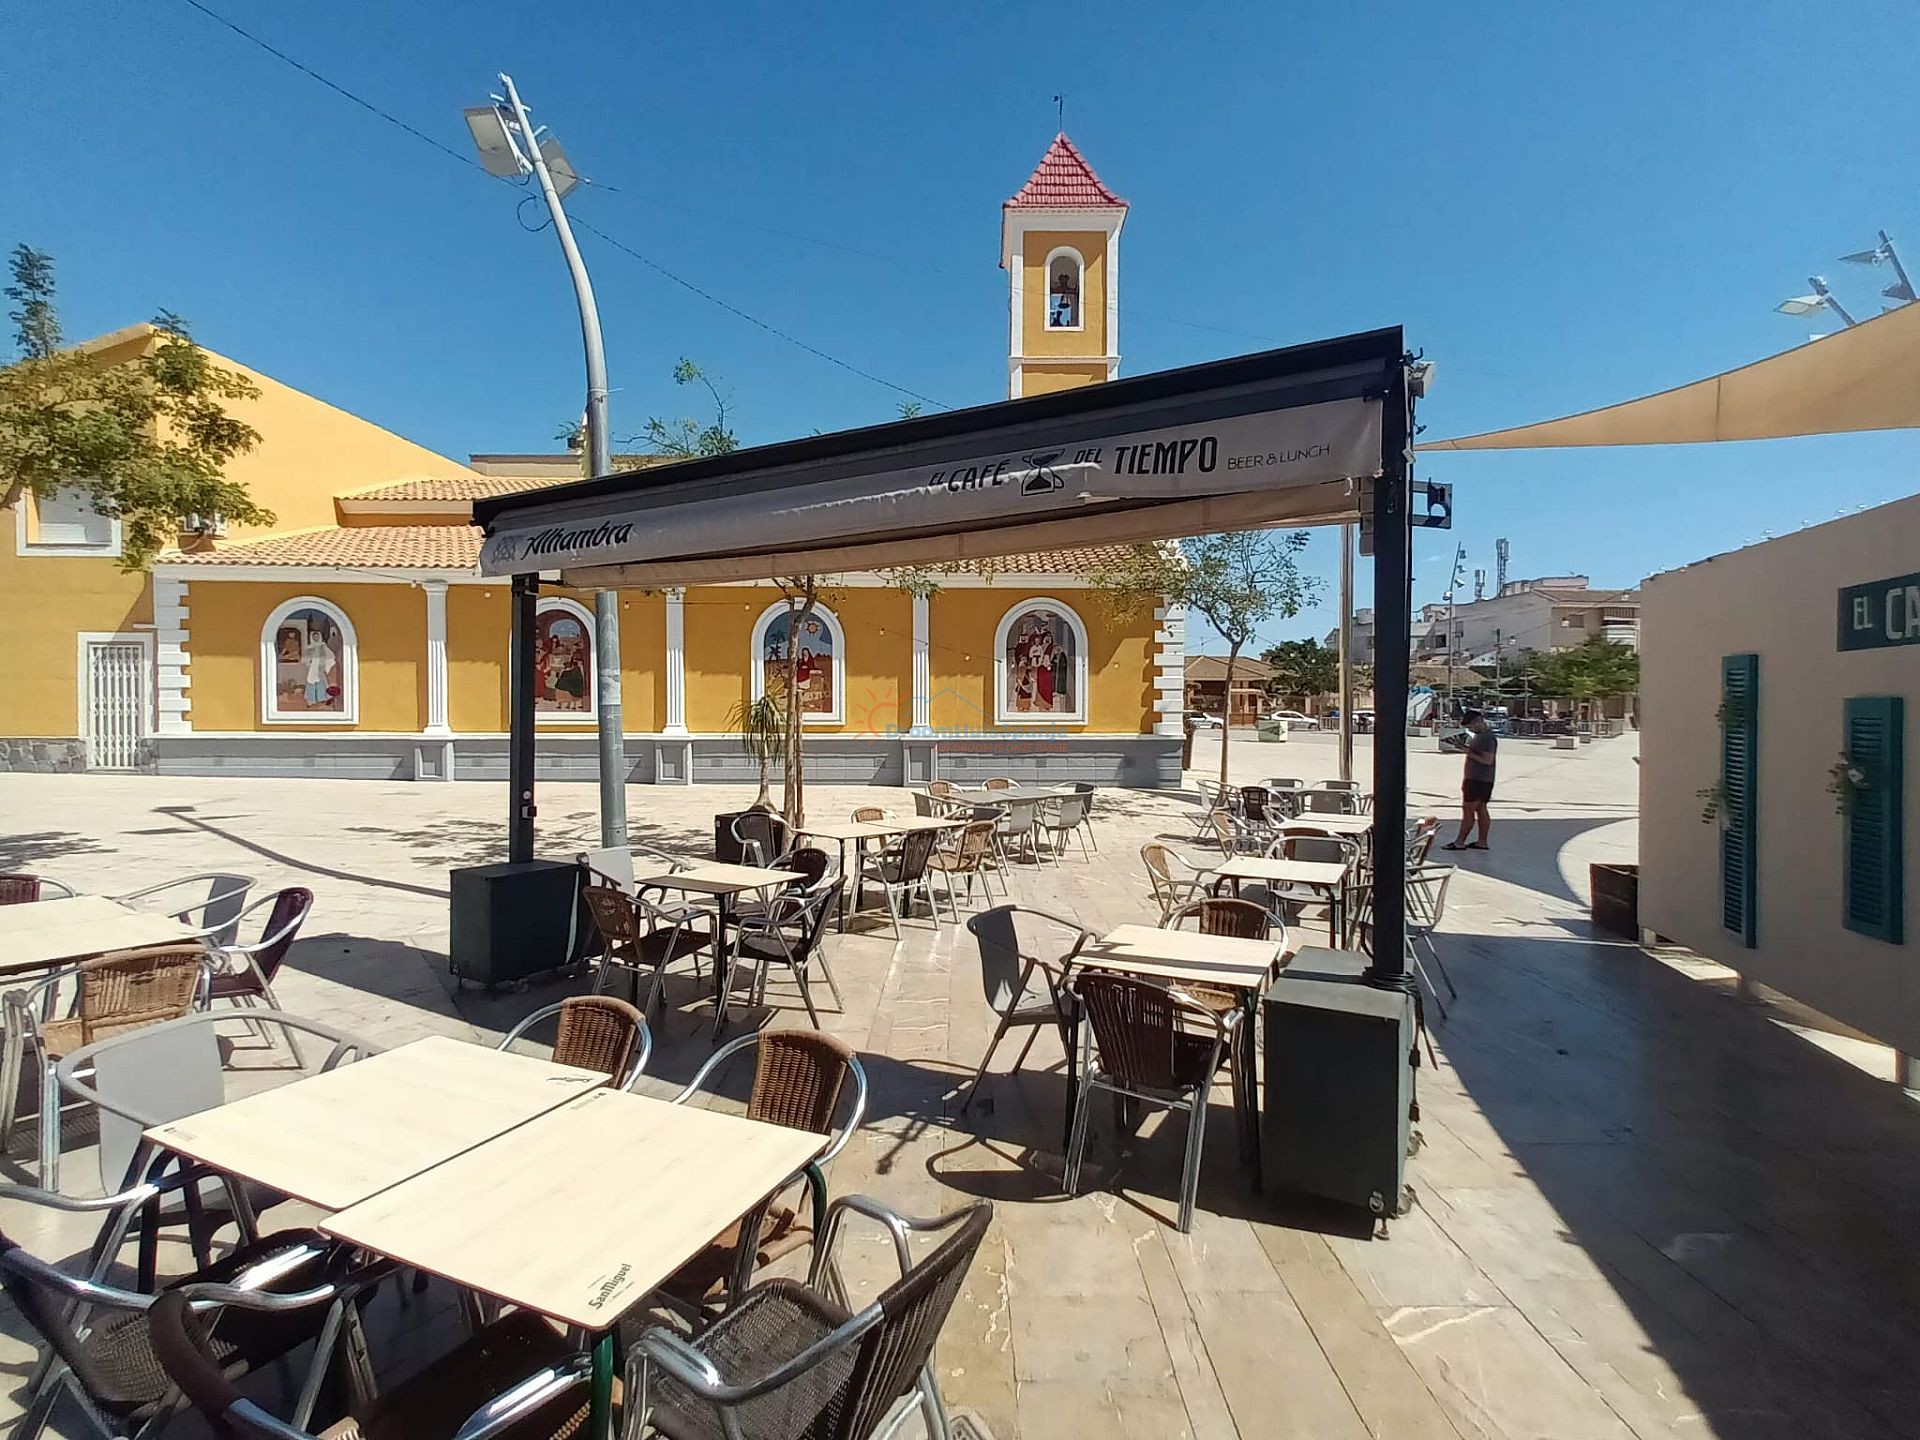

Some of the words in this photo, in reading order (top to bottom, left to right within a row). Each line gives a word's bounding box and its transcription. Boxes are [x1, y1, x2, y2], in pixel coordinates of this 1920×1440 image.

[1074, 448, 1102, 464] DEL
[1115, 436, 1218, 475] TIEMPO
[1227, 455, 1264, 470] BEER
[1266, 452, 1277, 466] &
[1279, 444, 1330, 463] LUNCH
[520, 520, 635, 561] Alhambra
[1853, 596, 1873, 630] EL
